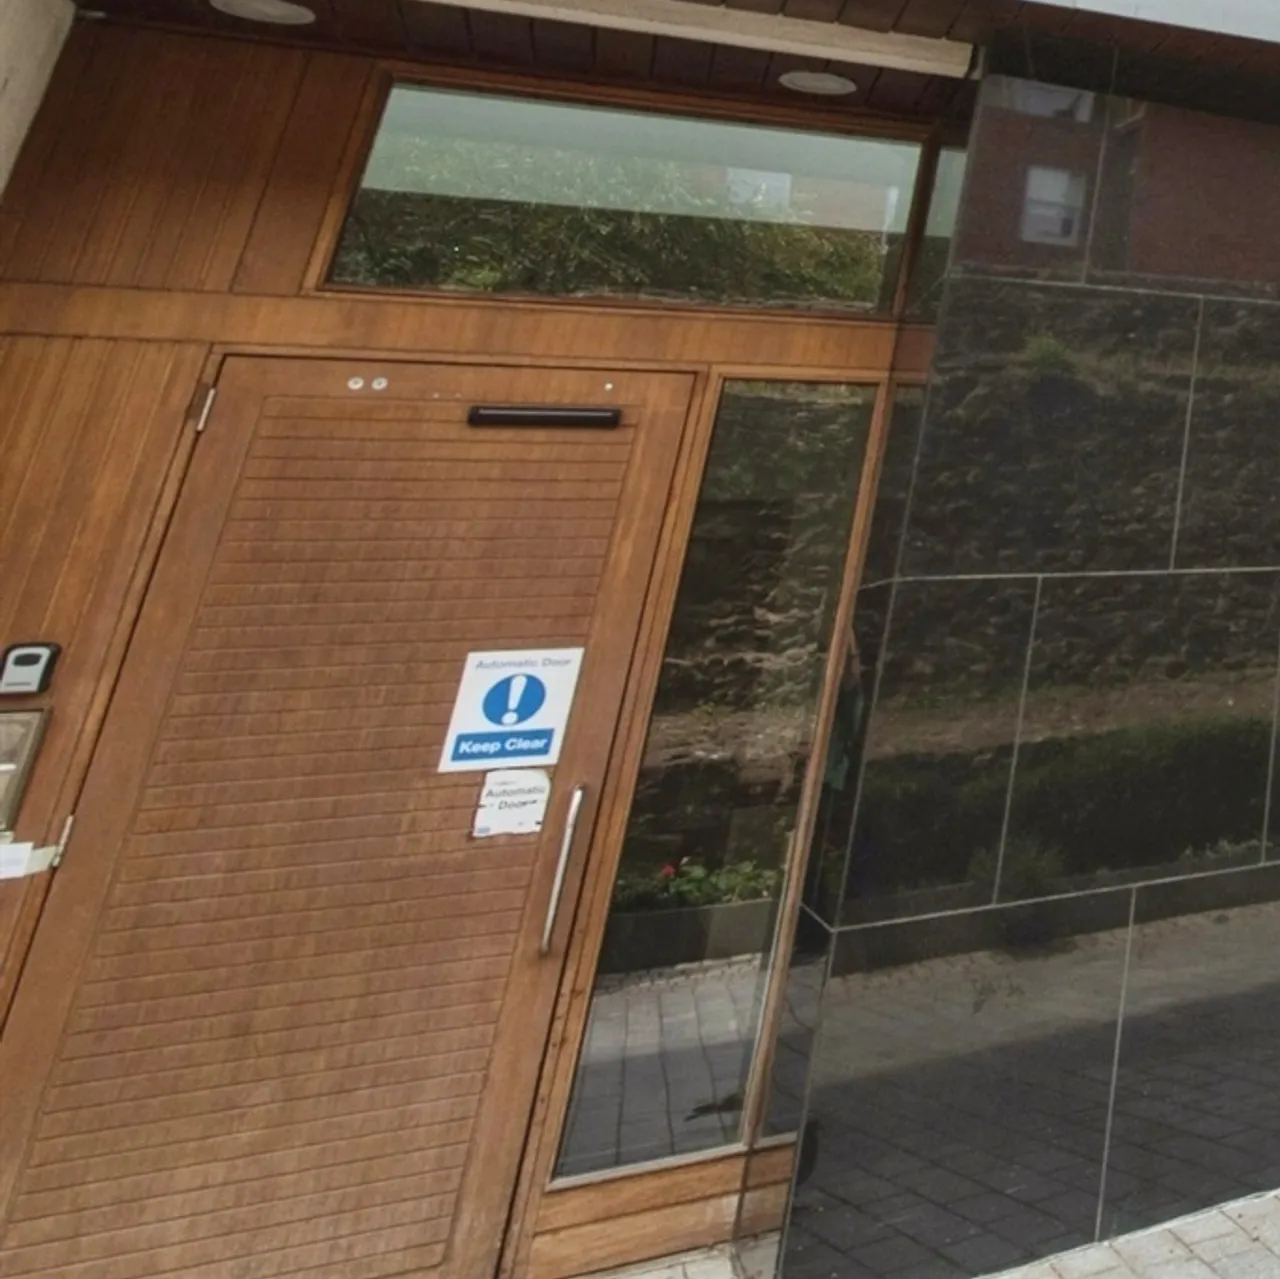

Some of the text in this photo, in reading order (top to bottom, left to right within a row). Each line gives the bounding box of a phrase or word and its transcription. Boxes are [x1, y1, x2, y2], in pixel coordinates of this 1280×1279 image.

[475, 656, 572, 670] Automatic Door
[458, 736, 549, 755] Keep Clear
